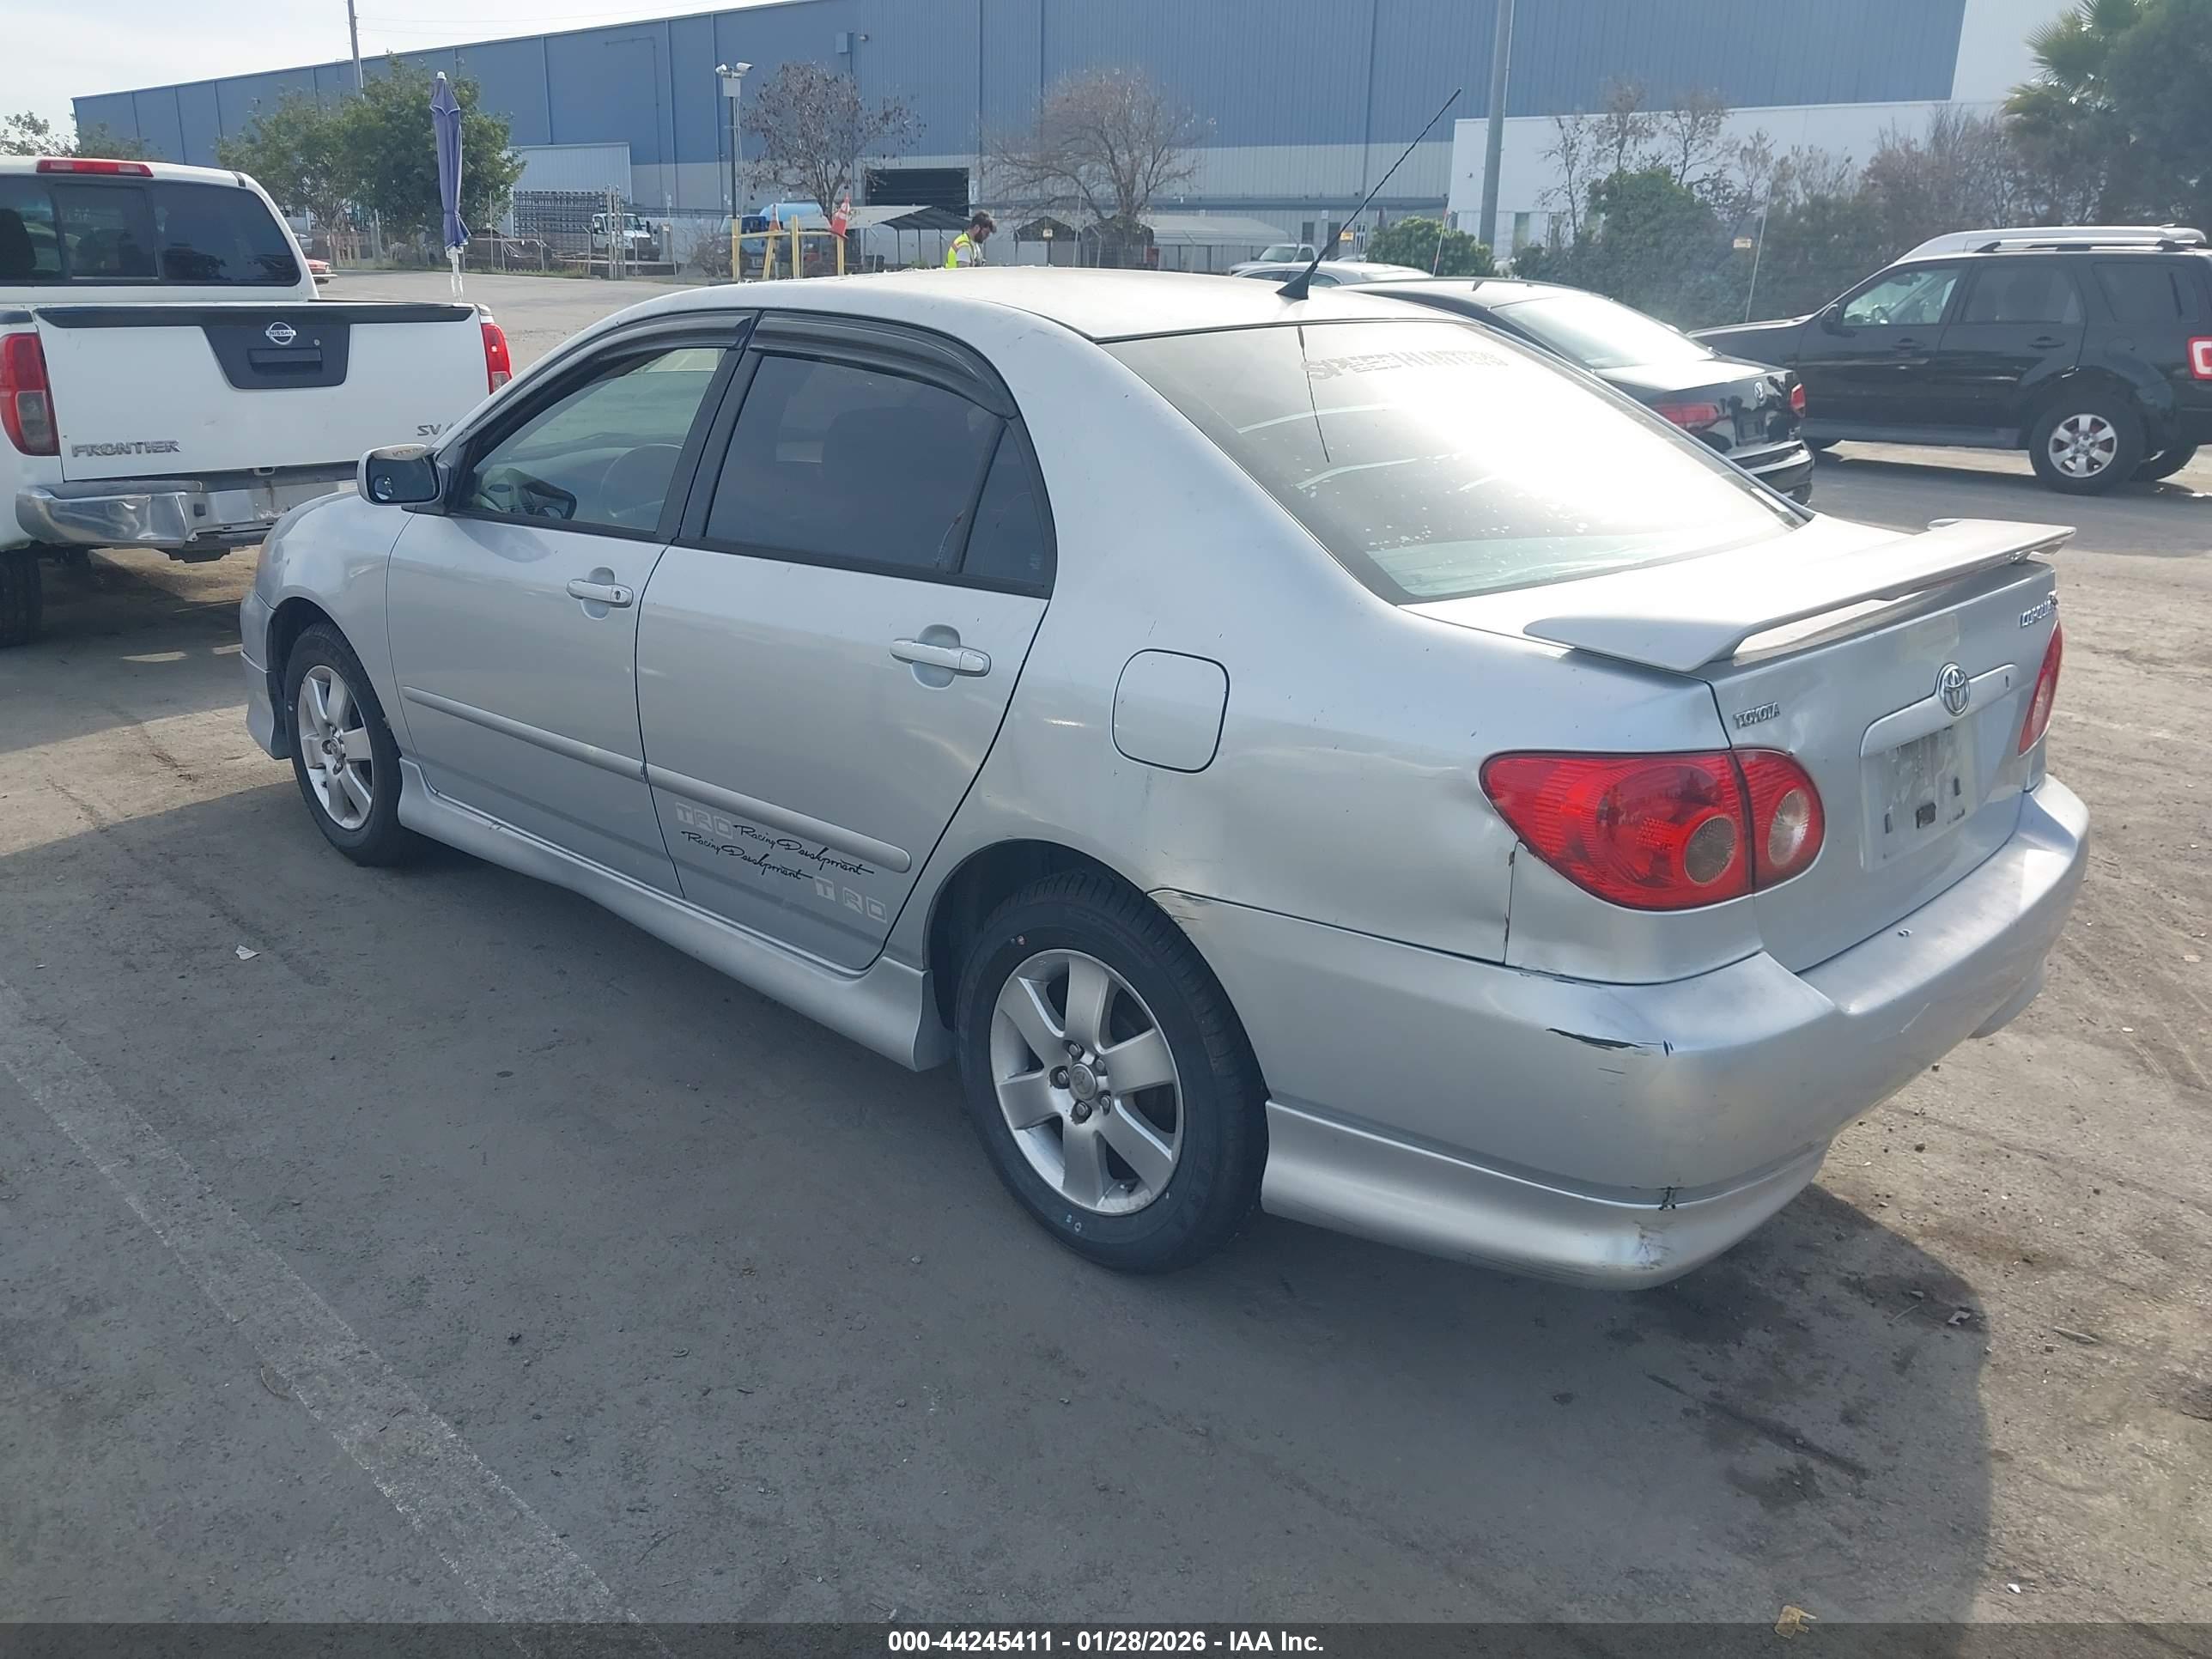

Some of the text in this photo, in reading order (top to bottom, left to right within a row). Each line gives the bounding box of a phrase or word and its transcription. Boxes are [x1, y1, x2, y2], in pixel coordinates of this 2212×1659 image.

[417, 423, 441, 436] SV
[70, 440, 180, 458] FRONTIER
[1733, 701, 1779, 729] TOYOTA
[676, 802, 734, 839] TRD
[732, 824, 776, 848] Racing
[681, 830, 720, 854] Racing
